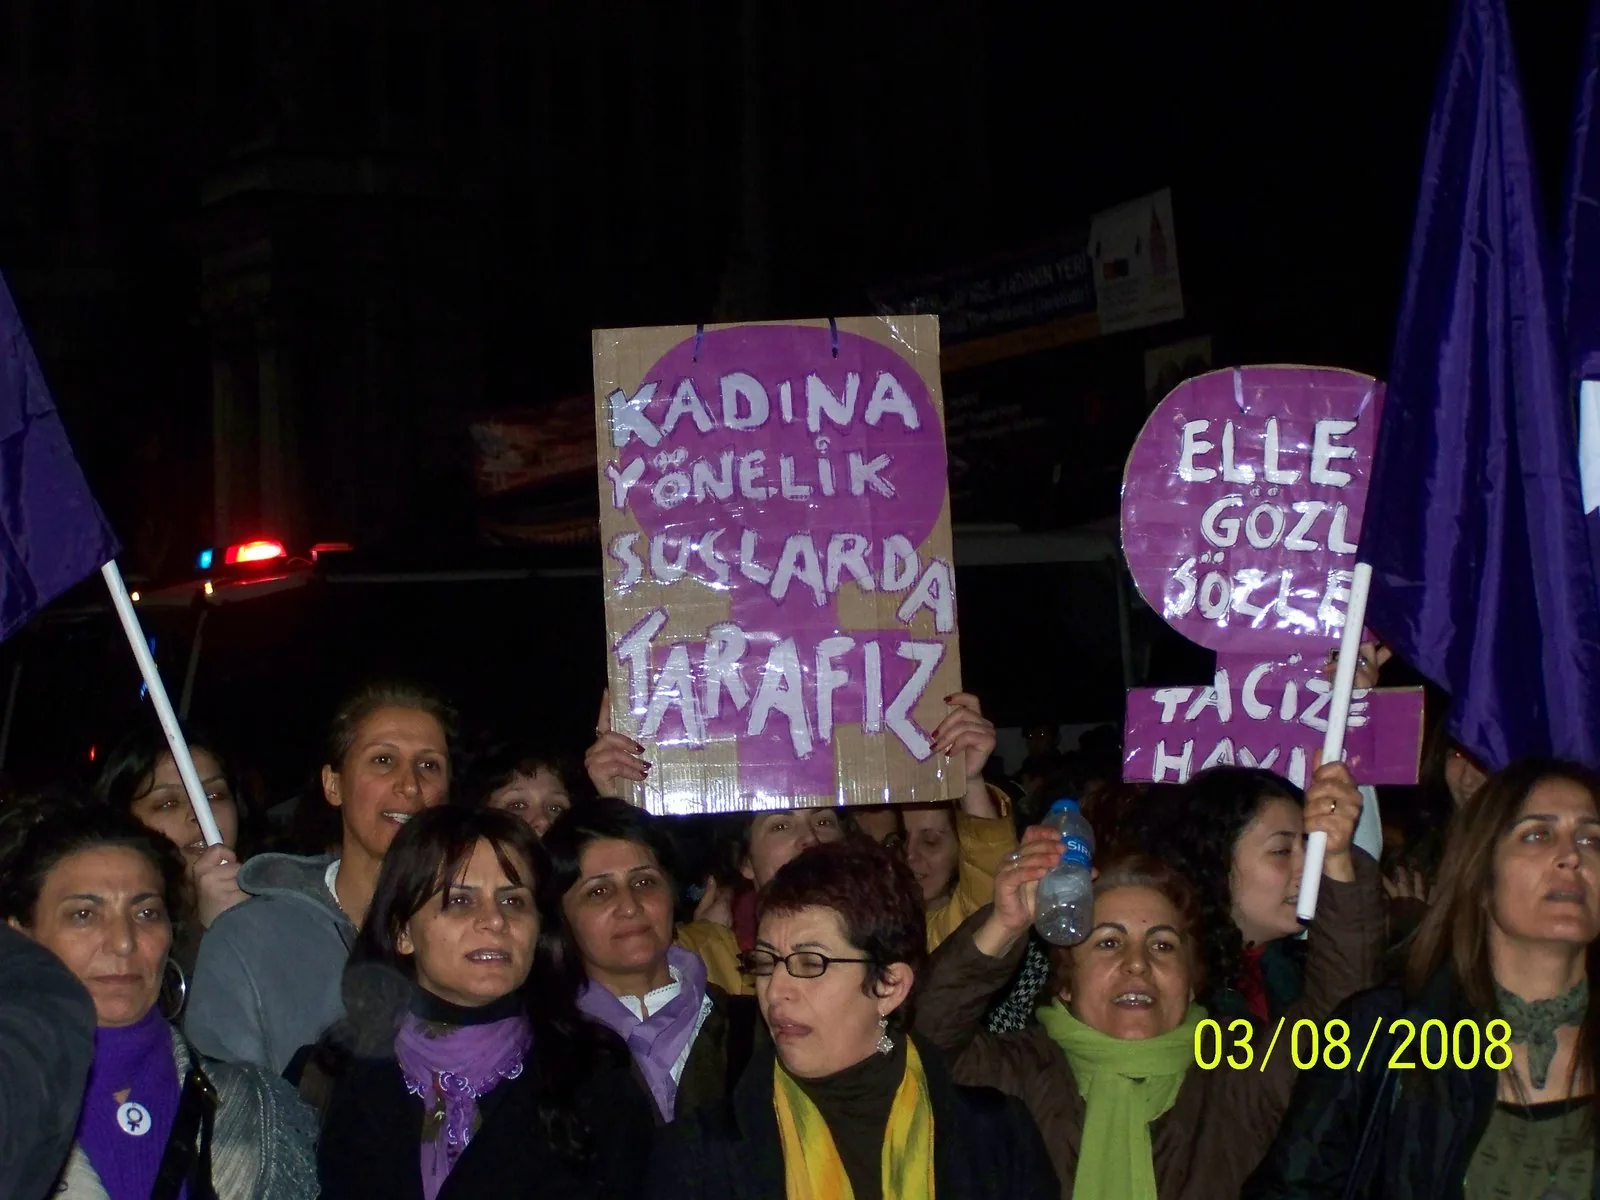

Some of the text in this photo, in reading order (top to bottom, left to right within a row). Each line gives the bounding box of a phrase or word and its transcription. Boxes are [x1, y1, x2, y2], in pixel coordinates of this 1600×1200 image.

[608, 371, 921, 448] KADINA
[605, 437, 896, 511] YÖNELİK
[1178, 416, 1358, 487] ELLE
[613, 608, 945, 762] TARAFIZ
[1152, 736, 1347, 790] HAYI
